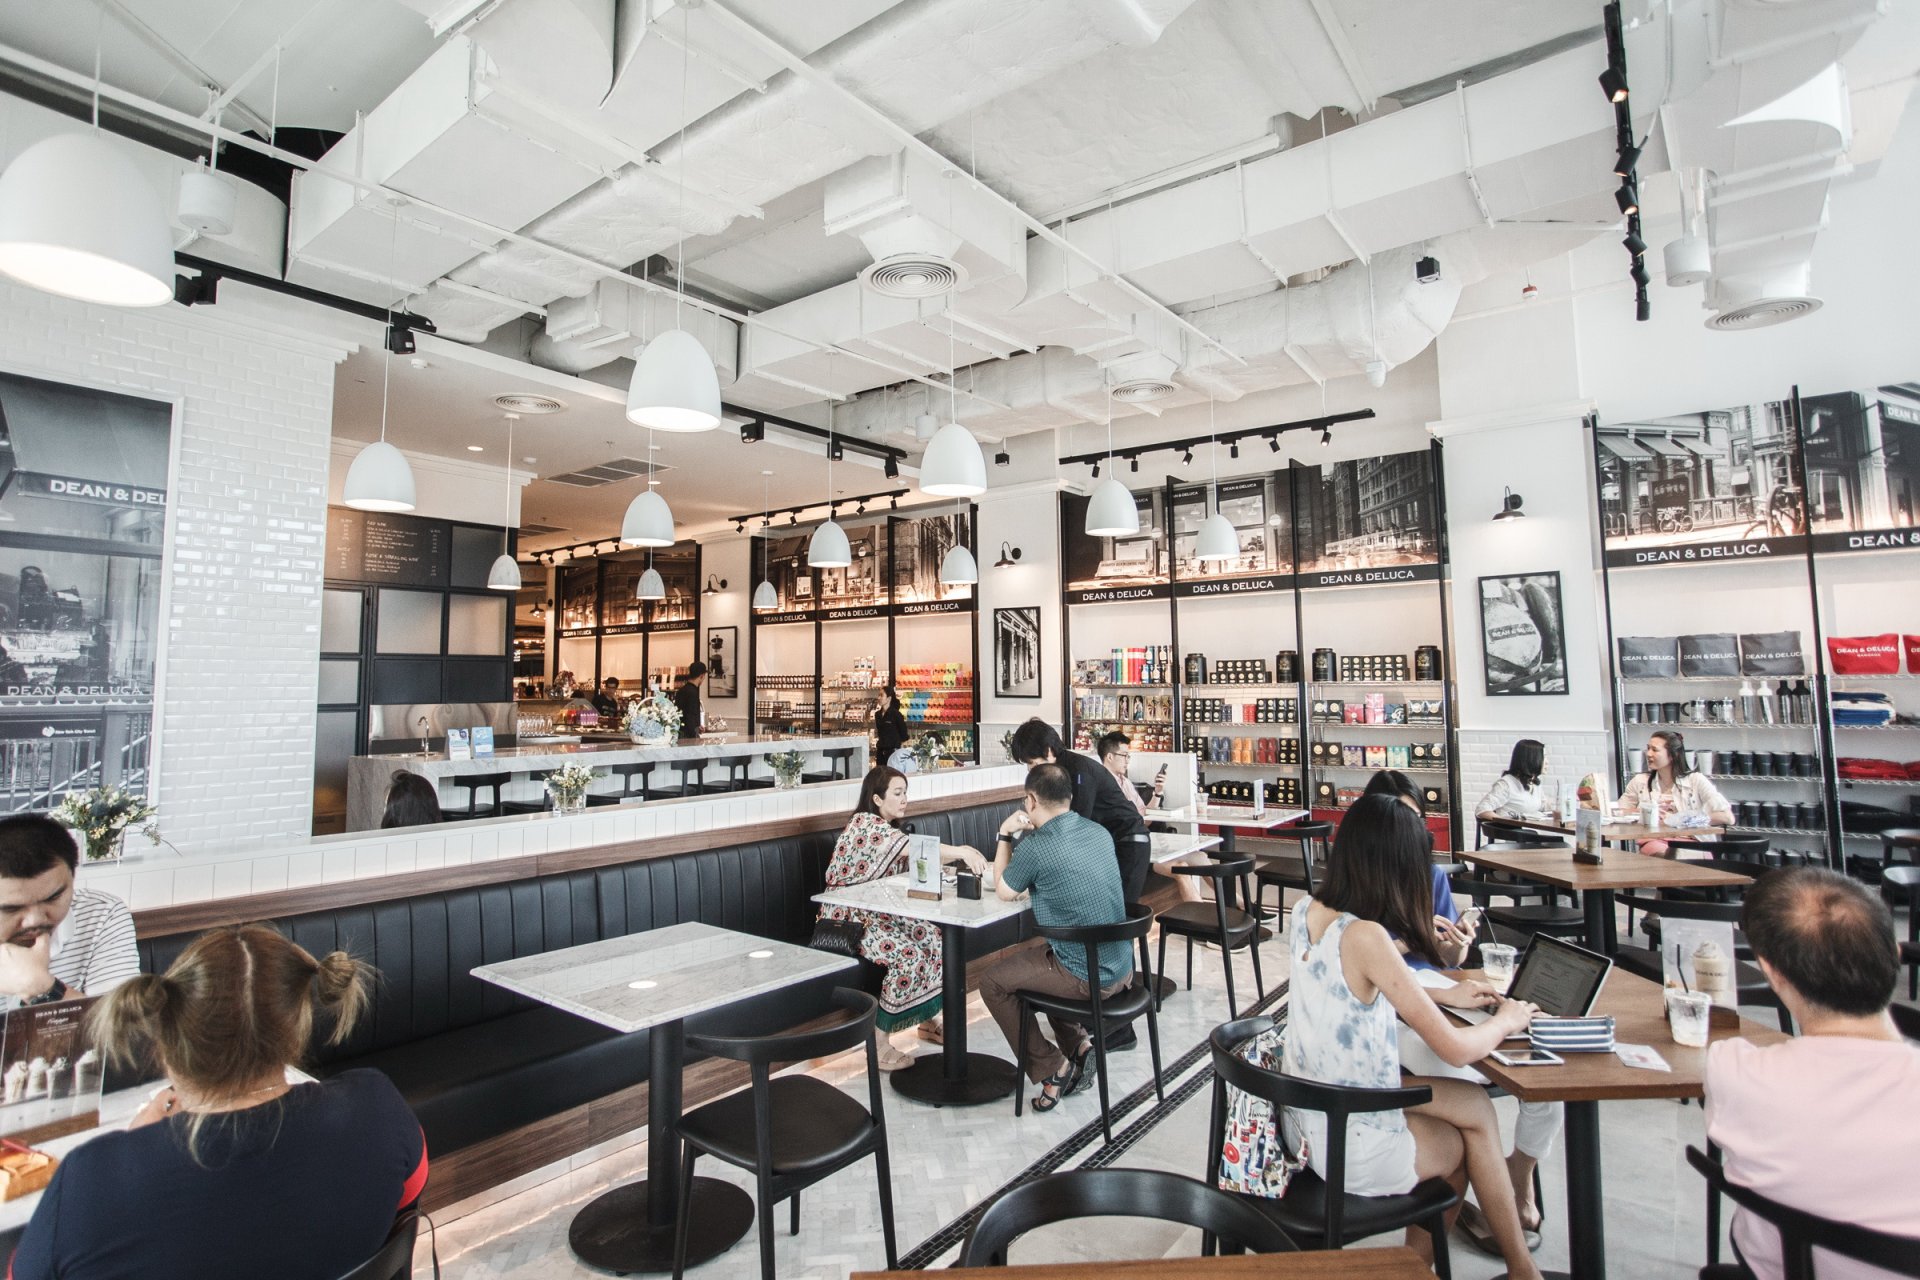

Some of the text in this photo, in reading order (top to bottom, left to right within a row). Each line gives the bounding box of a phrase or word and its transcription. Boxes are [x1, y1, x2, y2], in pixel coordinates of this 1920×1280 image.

[50, 480, 167, 506] DEAN & DEL
[1849, 534, 1904, 548] DEAN
[1636, 544, 1770, 563] DEAN & DELUCA
[1320, 570, 1415, 584] DEAN & DELUCA
[1193, 584, 1220, 593] DEAN
[1232, 580, 1274, 590] DELUCA
[1117, 589, 1153, 598] DELUCA
[930, 603, 959, 611] DELUCA
[8, 686, 56, 696] DEAN
[78, 686, 144, 696] DELUCA
